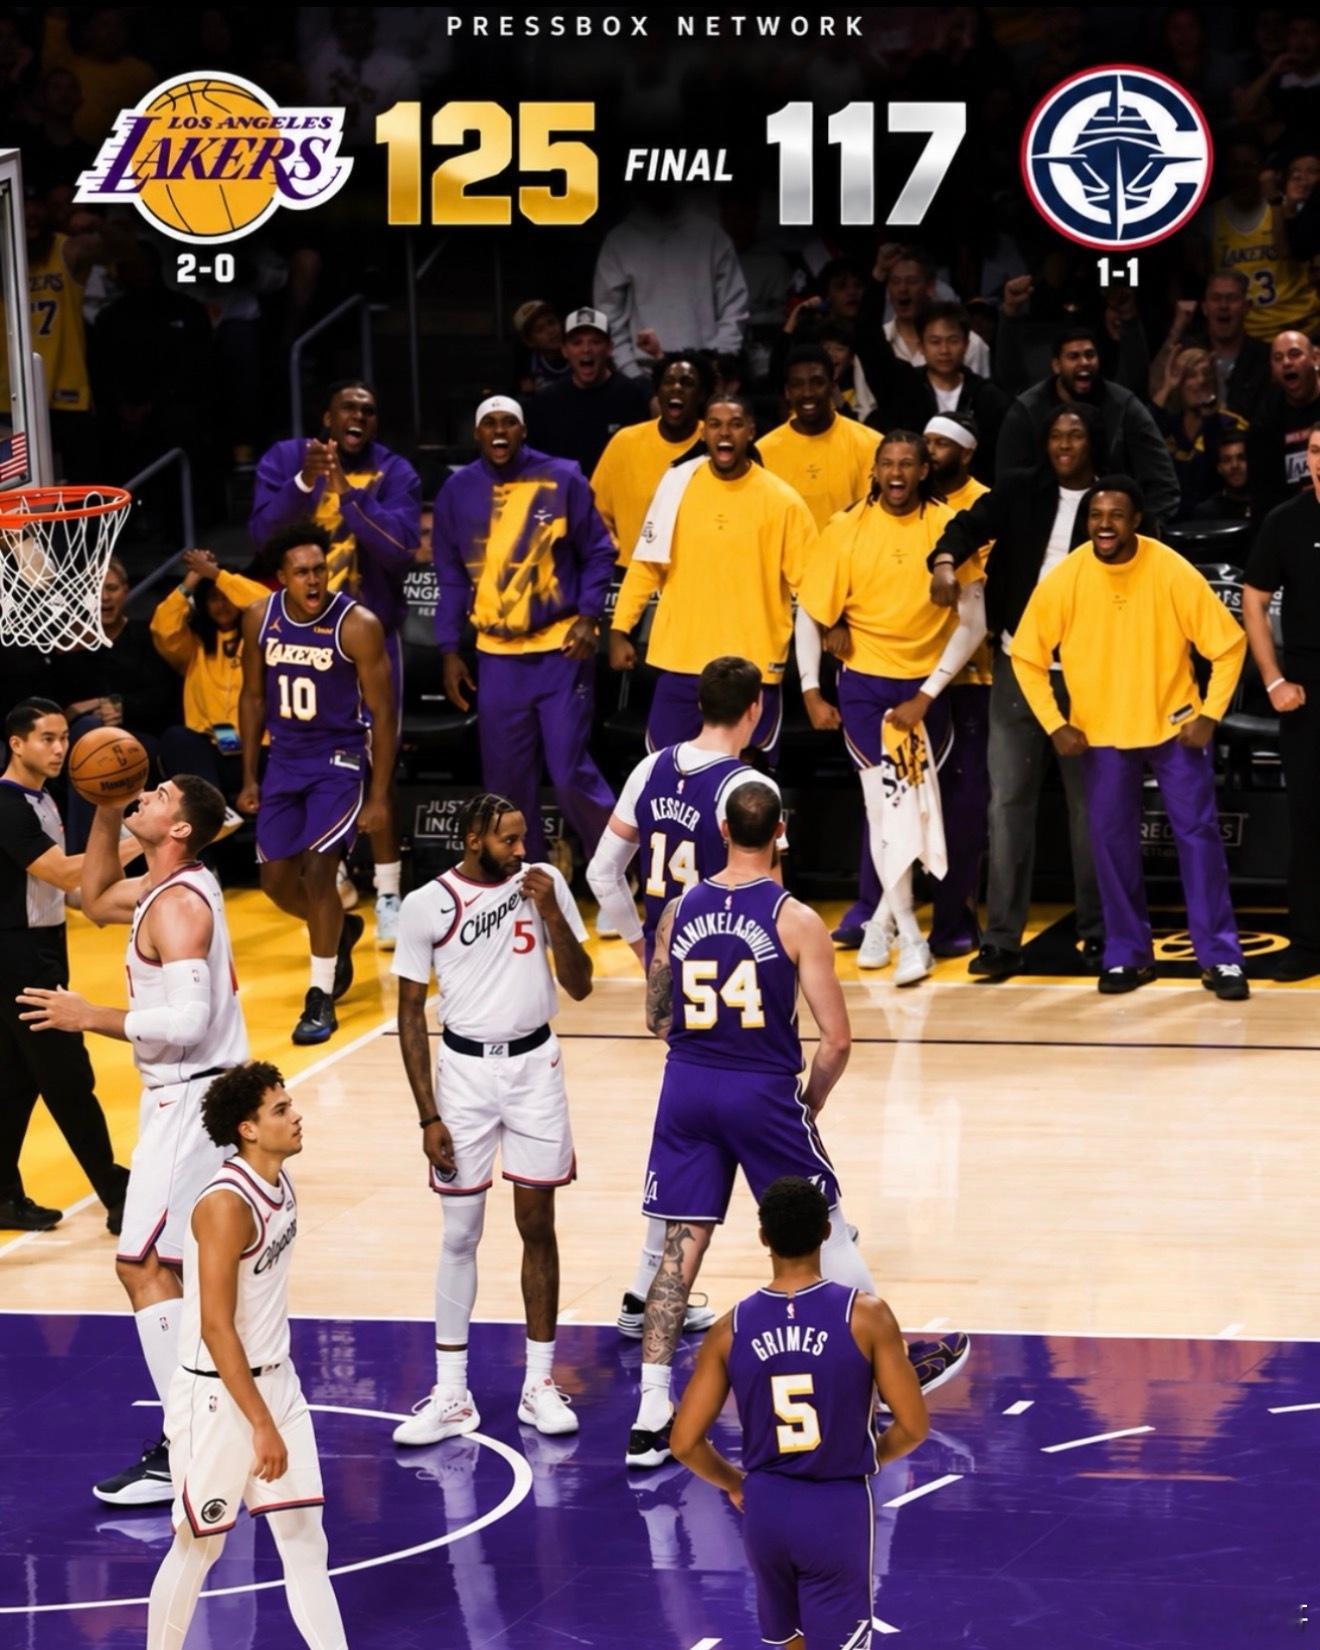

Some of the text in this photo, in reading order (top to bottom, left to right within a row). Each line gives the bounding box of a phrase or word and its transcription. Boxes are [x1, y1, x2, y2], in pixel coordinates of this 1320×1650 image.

[265, 637, 334, 671] LAKERS
[278, 674, 317, 721] 10
[650, 796, 700, 832] KESSLER
[646, 831, 700, 898] 14
[460, 890, 527, 946] Clippe
[512, 920, 536, 955] 5
[671, 912, 779, 963] MANUKELASHVILI
[682, 959, 765, 1030] 54
[751, 1325, 829, 1362] GRIMES
[771, 1373, 822, 1454] 5
